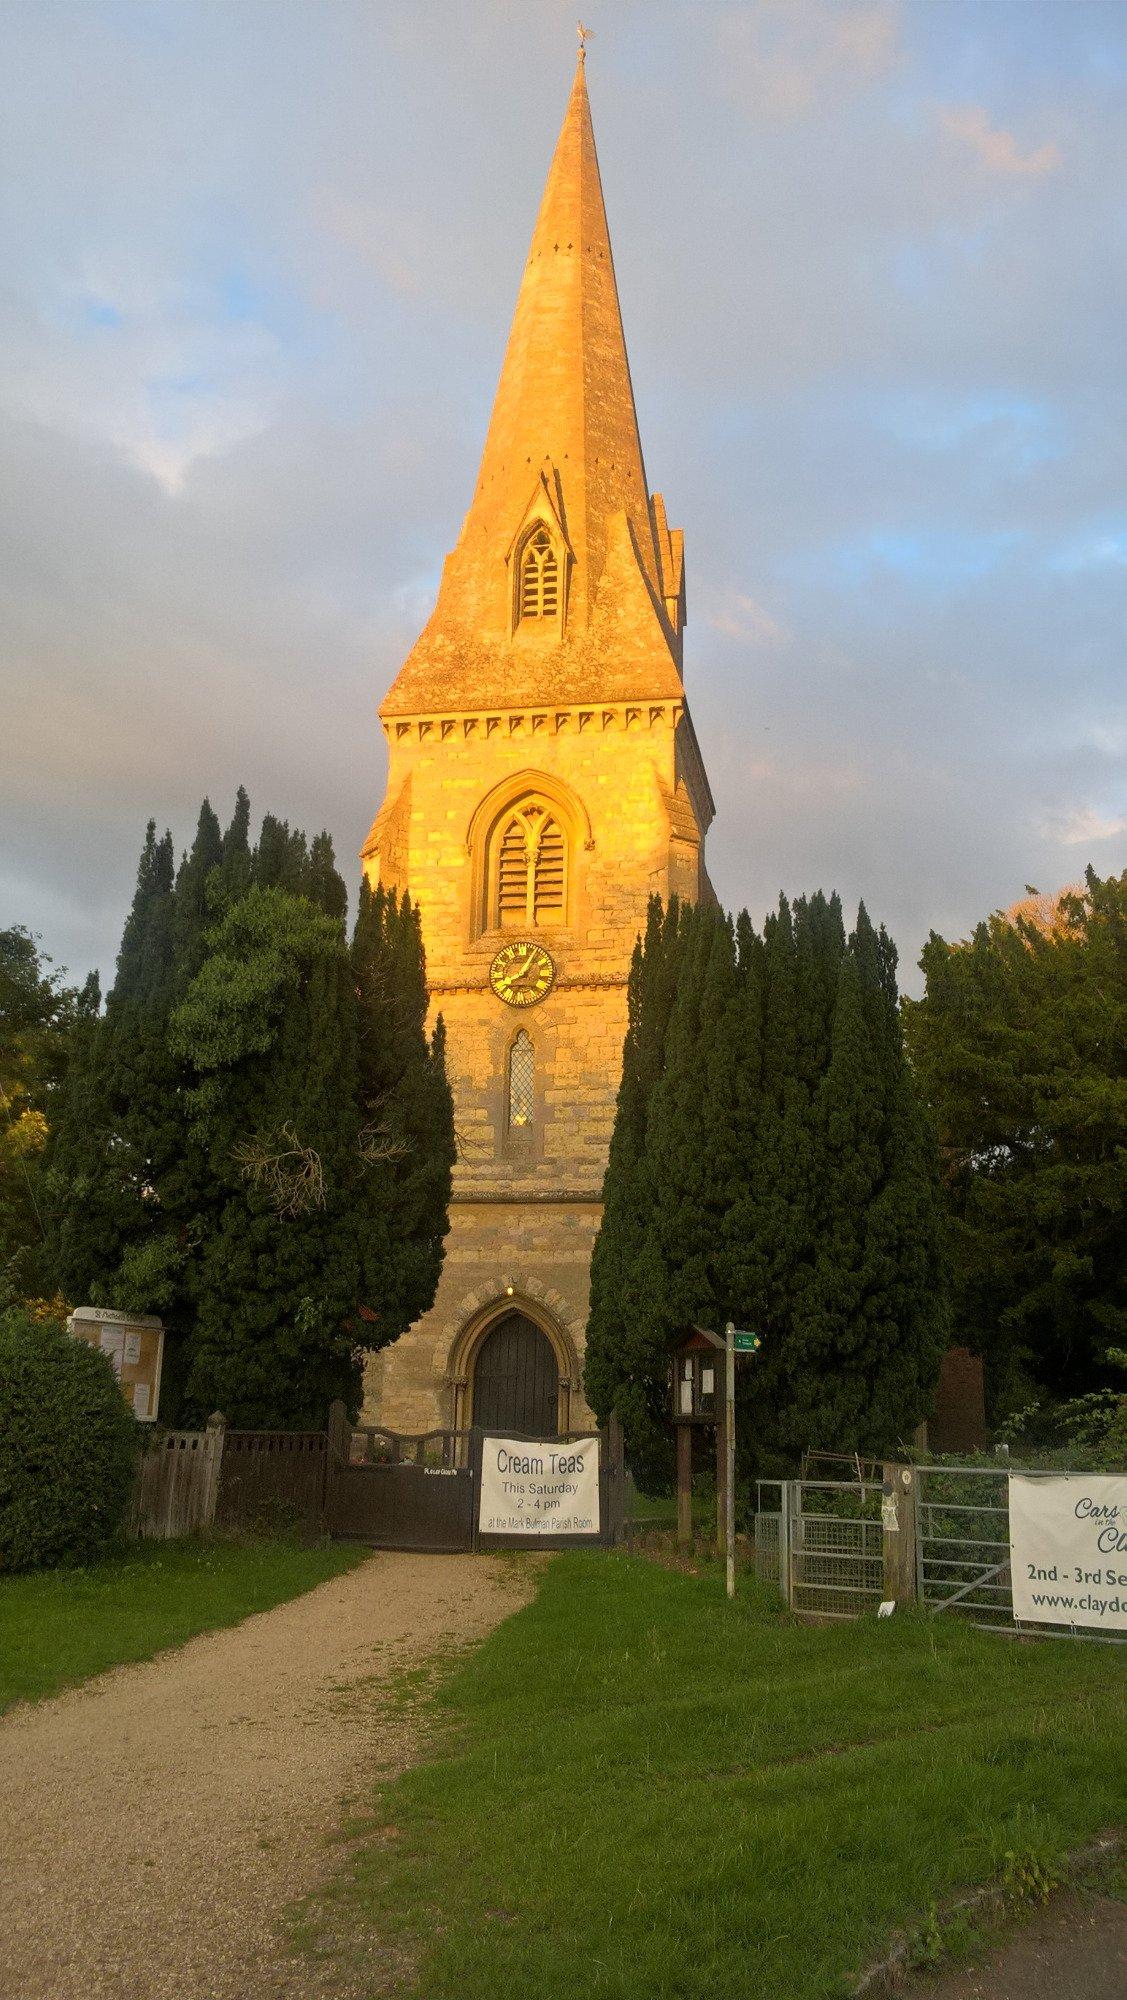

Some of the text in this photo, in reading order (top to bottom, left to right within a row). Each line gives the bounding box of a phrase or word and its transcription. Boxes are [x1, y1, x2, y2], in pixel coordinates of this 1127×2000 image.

[497, 1449, 585, 1475] Cream Teas
[502, 1481, 578, 1496] This Saturday
[516, 1499, 524, 1508] 2
[534, 1499, 541, 1510] 4
[544, 1500, 560, 1510] pm
[1075, 1498, 1120, 1518] Cars
[496, 1517, 506, 1528] the
[574, 1516, 592, 1528] Room
[1028, 1564, 1057, 1582] 2nd
[1074, 1567, 1100, 1584] 3rd
